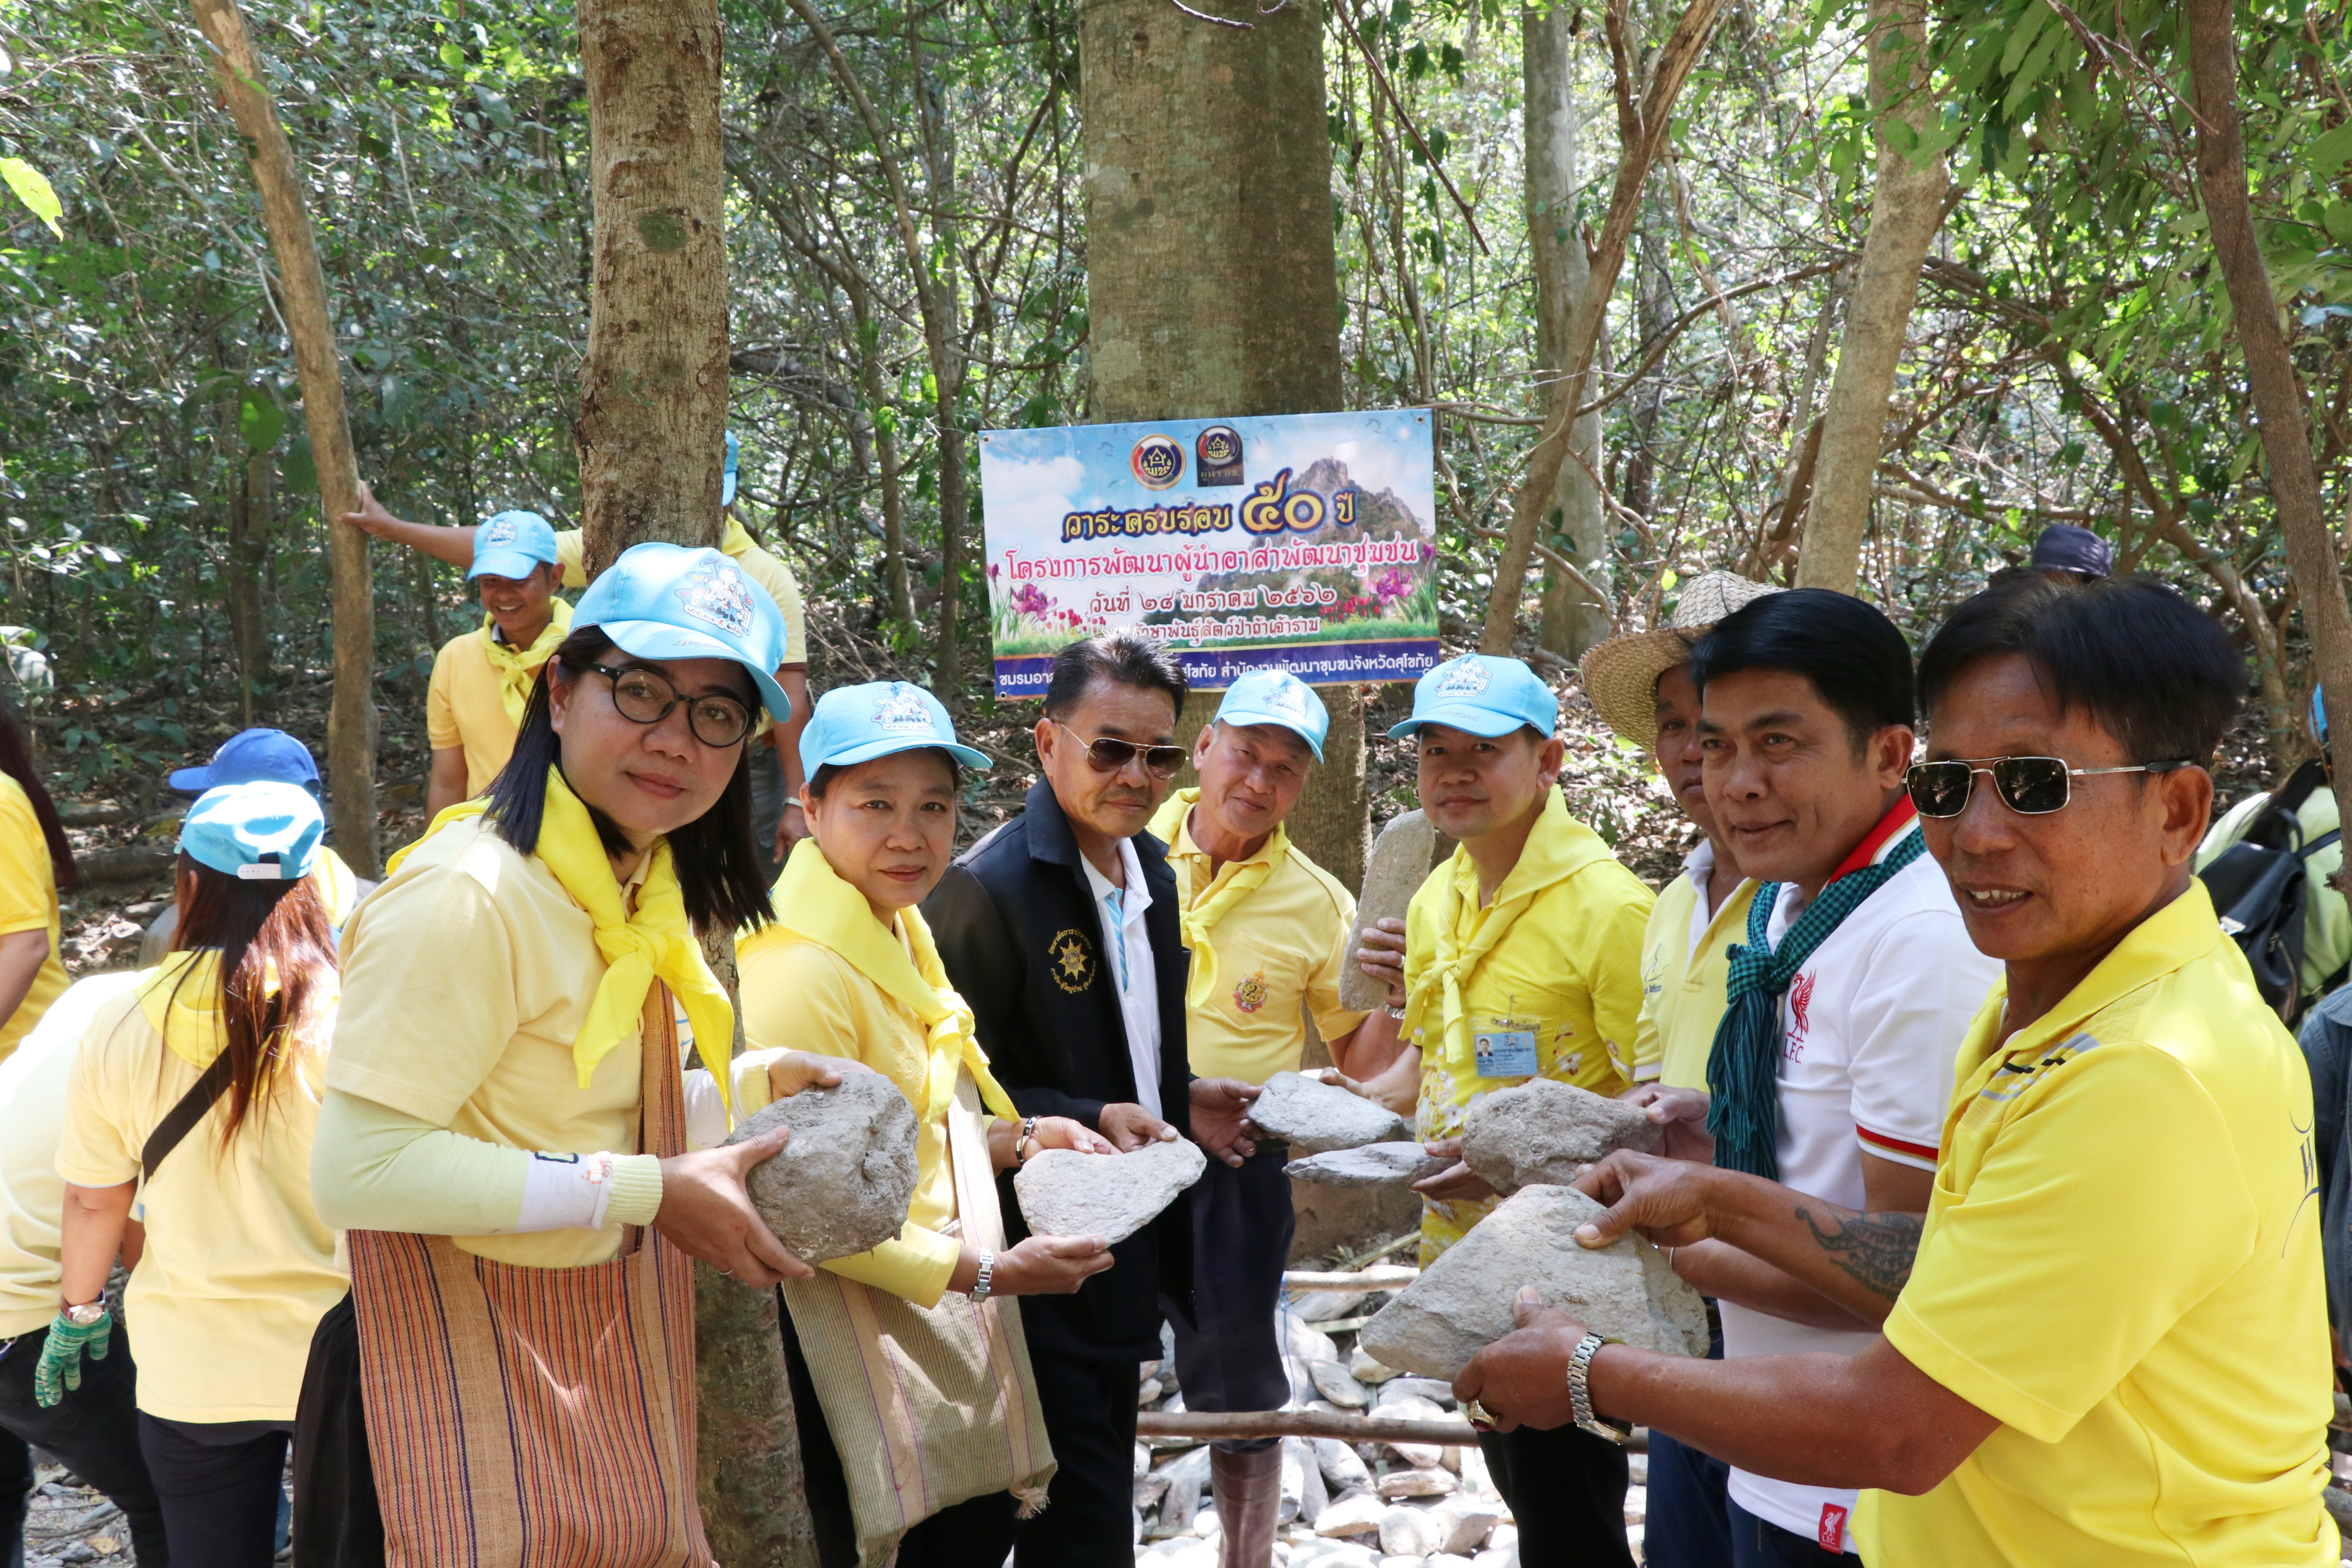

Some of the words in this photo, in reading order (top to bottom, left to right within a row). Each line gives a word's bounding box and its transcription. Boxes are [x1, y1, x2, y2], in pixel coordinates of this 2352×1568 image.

[1064, 504, 1232, 539] วาระครบรอบ
[1241, 471, 1324, 532] ๕๐
[1335, 492, 1355, 523] ปี
[1004, 534, 1417, 582] โครงการพัฒนาผู้นำอาสาพัฒนาชุมชน
[1090, 585, 1131, 613] วันที่
[1139, 589, 1174, 611] ๒๘
[1183, 589, 1255, 610] มกราคม
[1260, 583, 1336, 604] ๒๕๖๒
